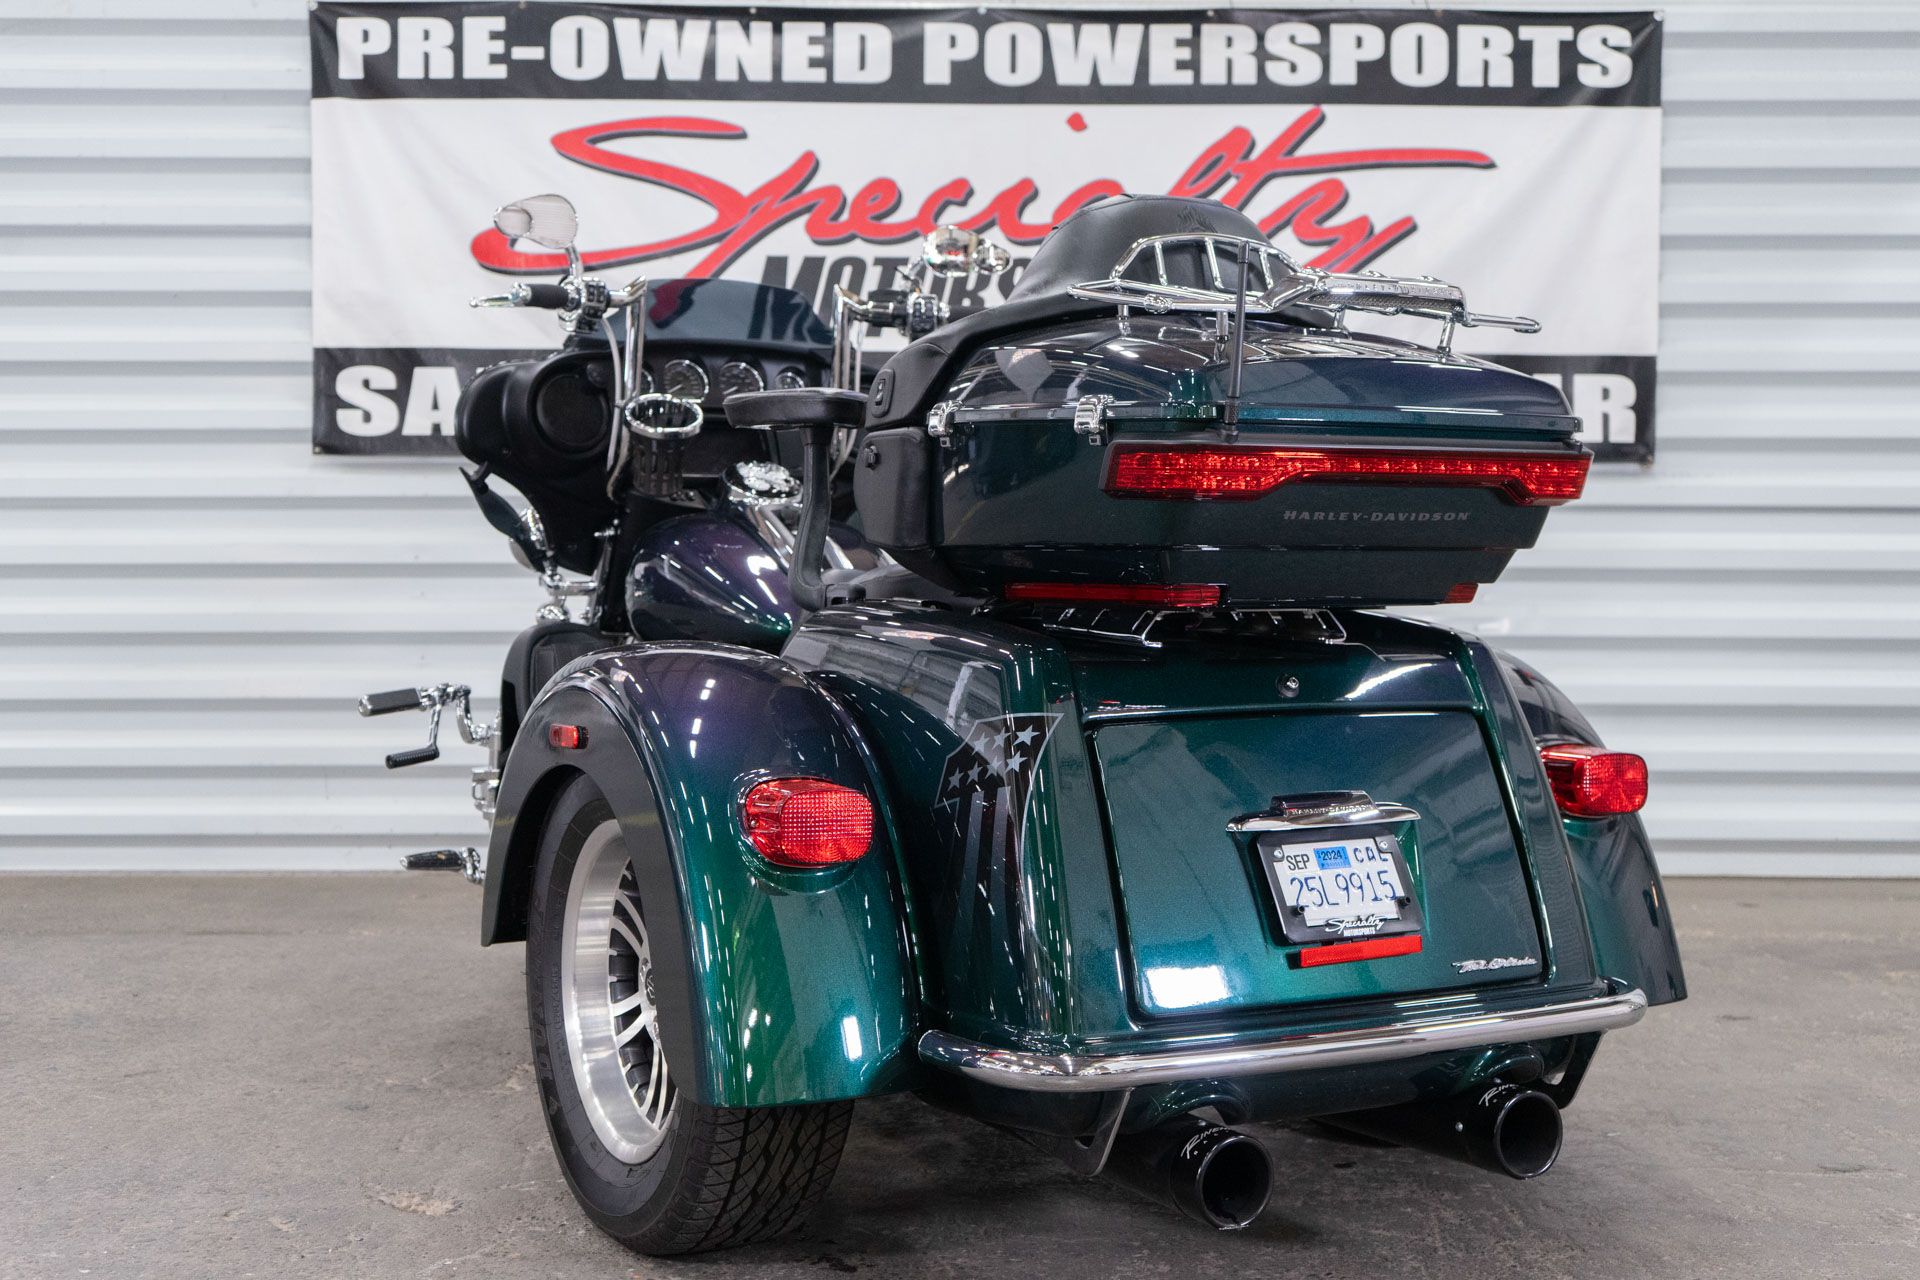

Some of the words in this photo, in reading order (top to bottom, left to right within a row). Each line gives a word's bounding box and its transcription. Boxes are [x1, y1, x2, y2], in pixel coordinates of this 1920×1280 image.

[335, 14, 894, 86] PRE-OWNED
[921, 21, 1634, 90] POWERSPORTS
[470, 104, 1496, 282] Specialty
[1282, 510, 1470, 522] HARLEY-DAVIDSON
[1286, 854, 1310, 870] SEP
[1321, 850, 1343, 861] 2024
[1290, 870, 1396, 908] 25L9915
